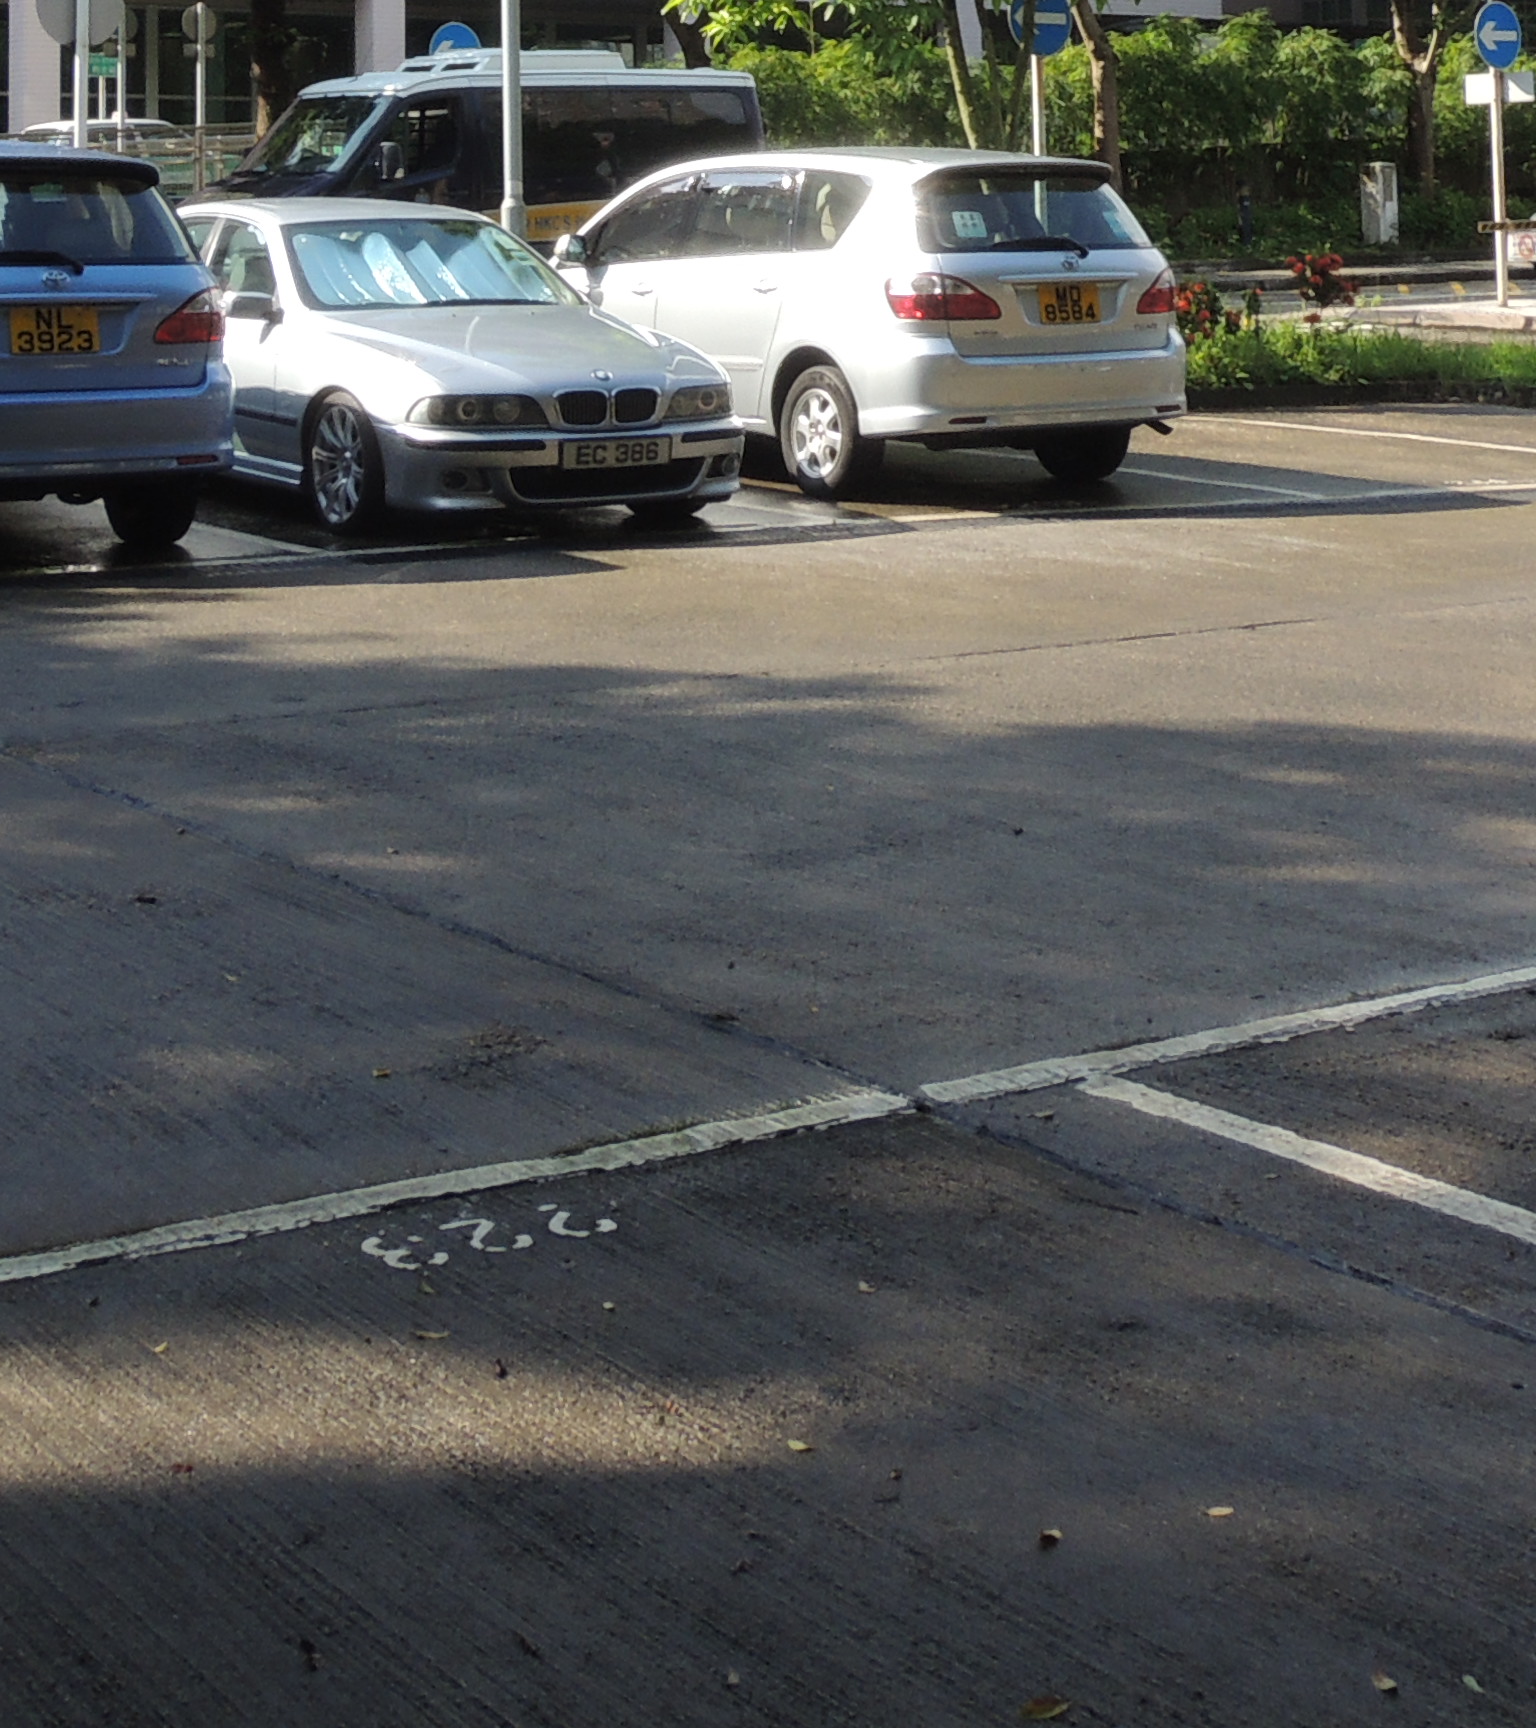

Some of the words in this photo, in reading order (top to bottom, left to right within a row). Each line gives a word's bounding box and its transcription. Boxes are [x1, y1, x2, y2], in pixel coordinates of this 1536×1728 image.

[35, 309, 74, 329] NL
[1044, 303, 1097, 322] 8584
[17, 330, 94, 352] 3923
[576, 444, 607, 465] EC
[615, 441, 660, 464] 386
